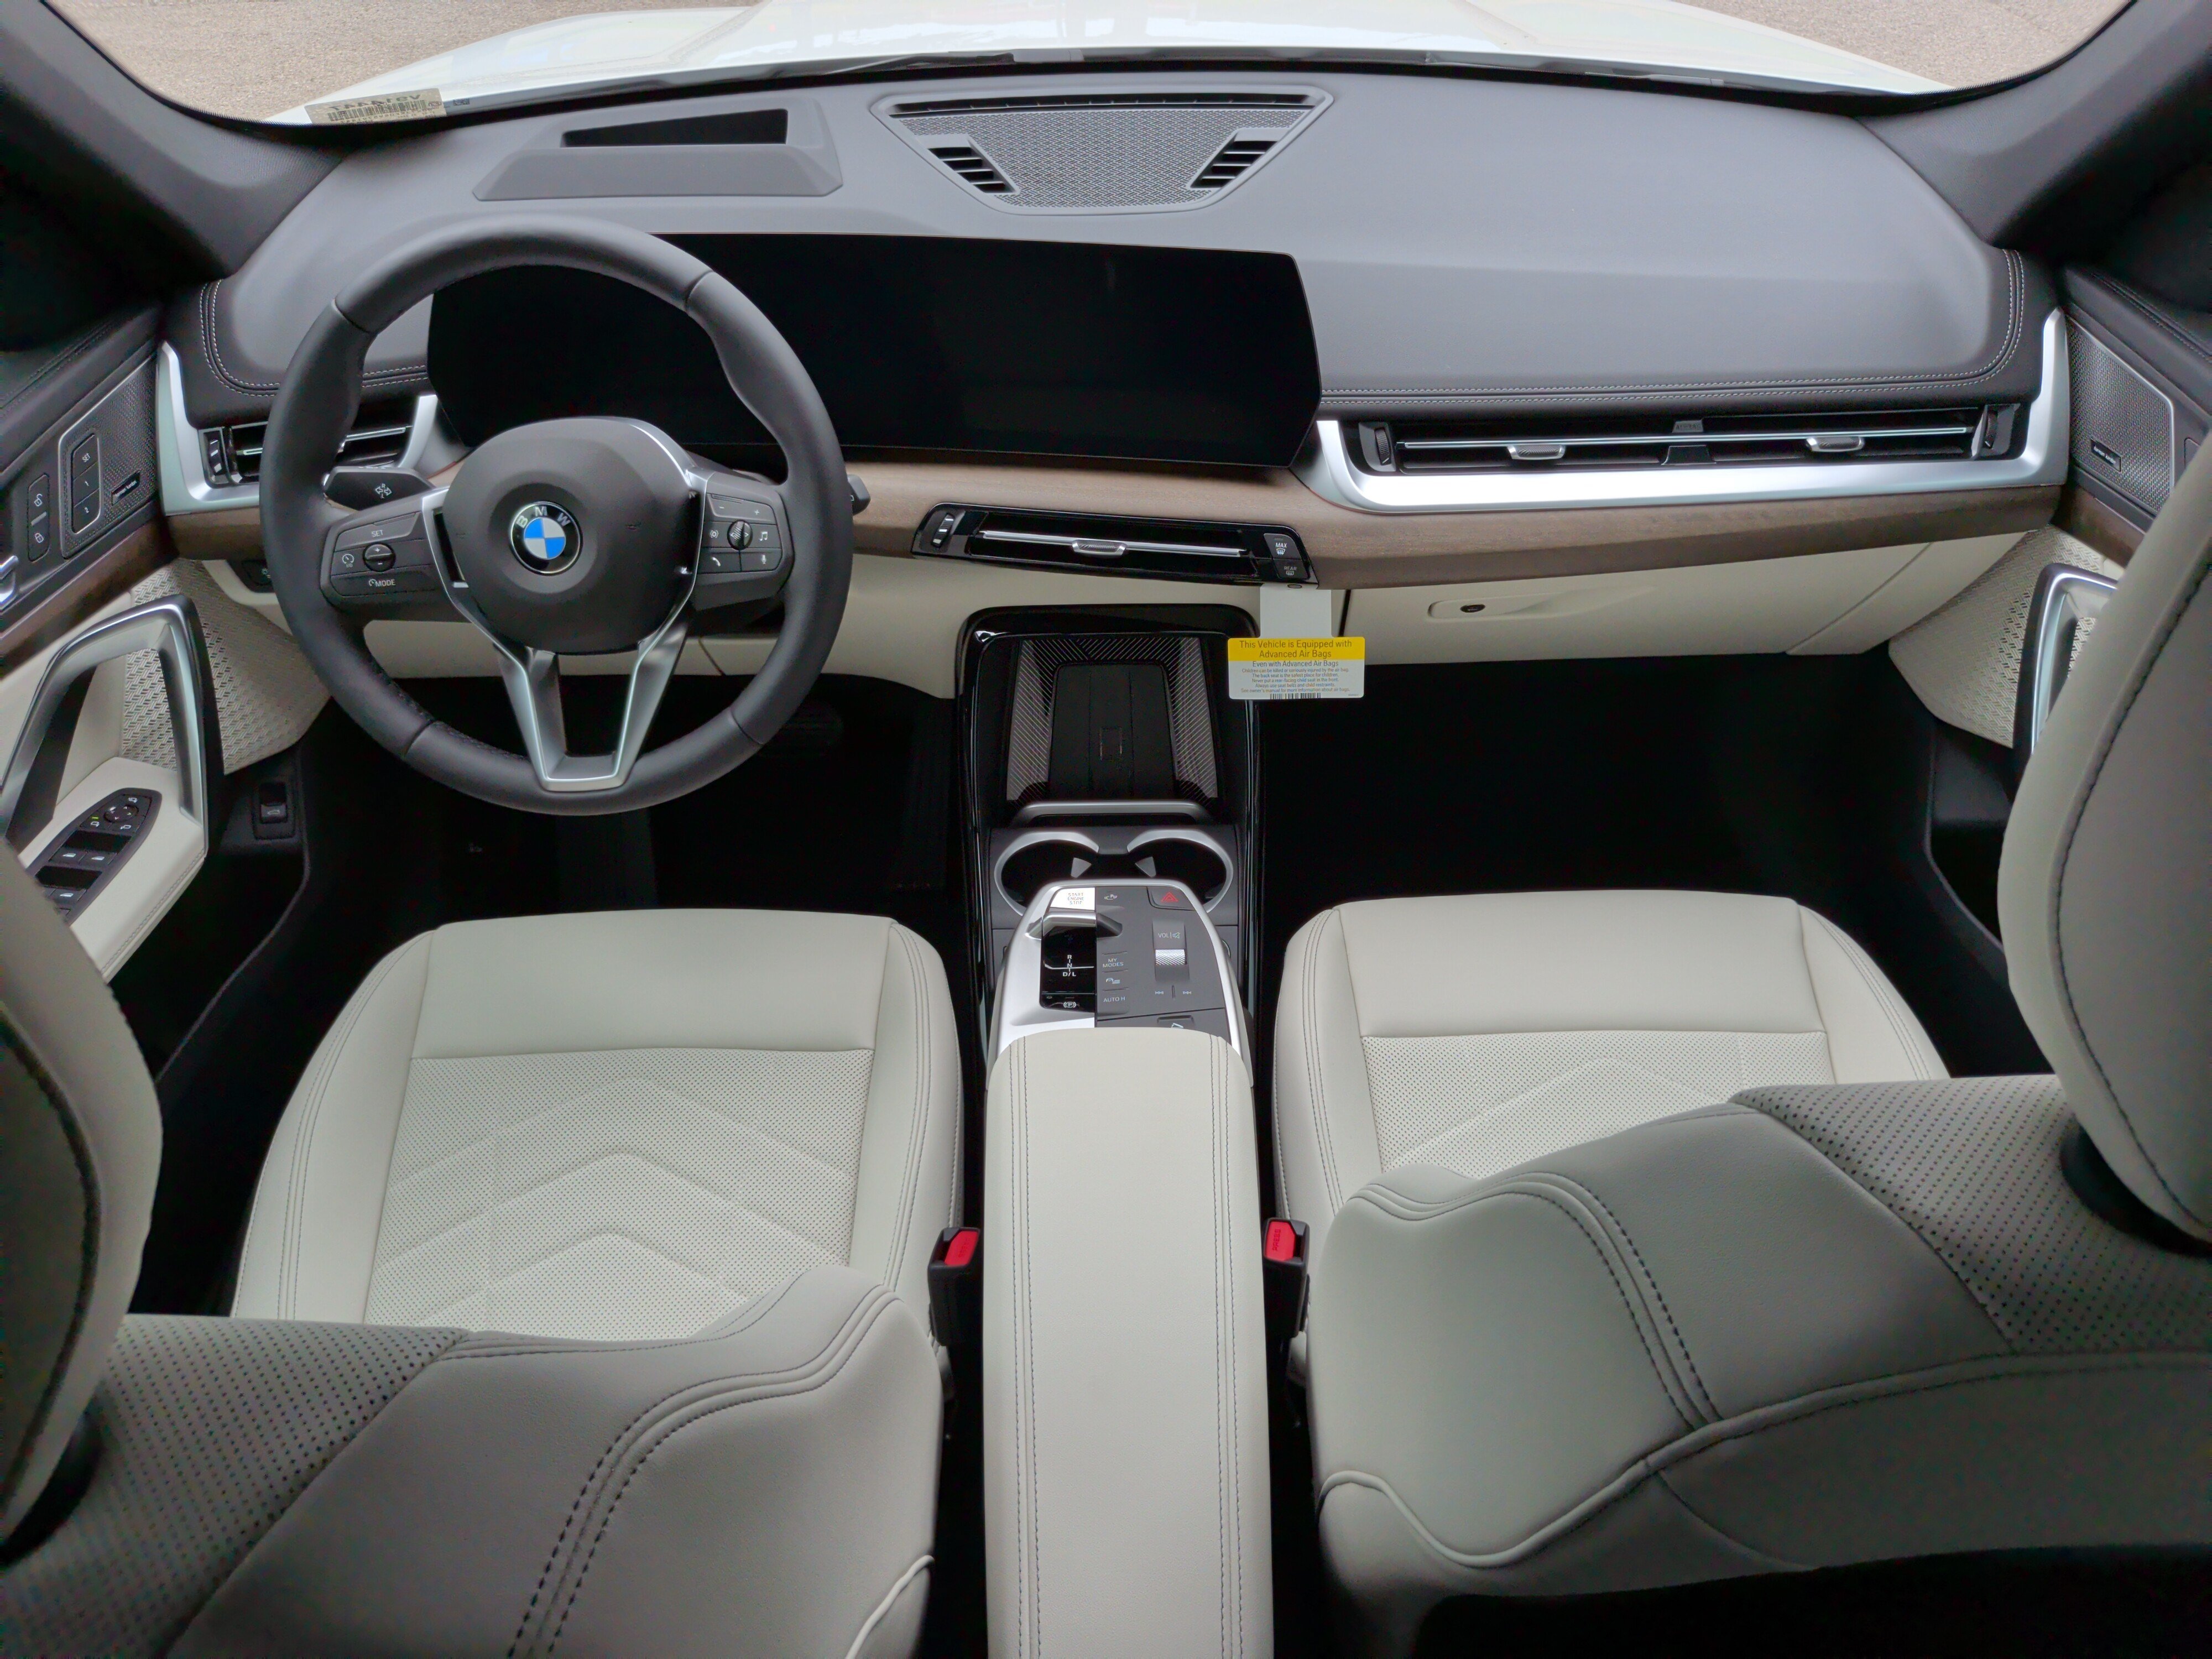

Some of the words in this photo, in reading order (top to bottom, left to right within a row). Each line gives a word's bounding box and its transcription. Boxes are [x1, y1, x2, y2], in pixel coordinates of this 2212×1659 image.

[82, 453, 91, 463] SET
[516, 506, 571, 529] BMW
[375, 579, 396, 587] MODE
[1258, 640, 1286, 648] Vehicle
[1296, 640, 1334, 649] Equipped
[1259, 650, 1297, 658] Advanced
[1312, 650, 1332, 659] Bags
